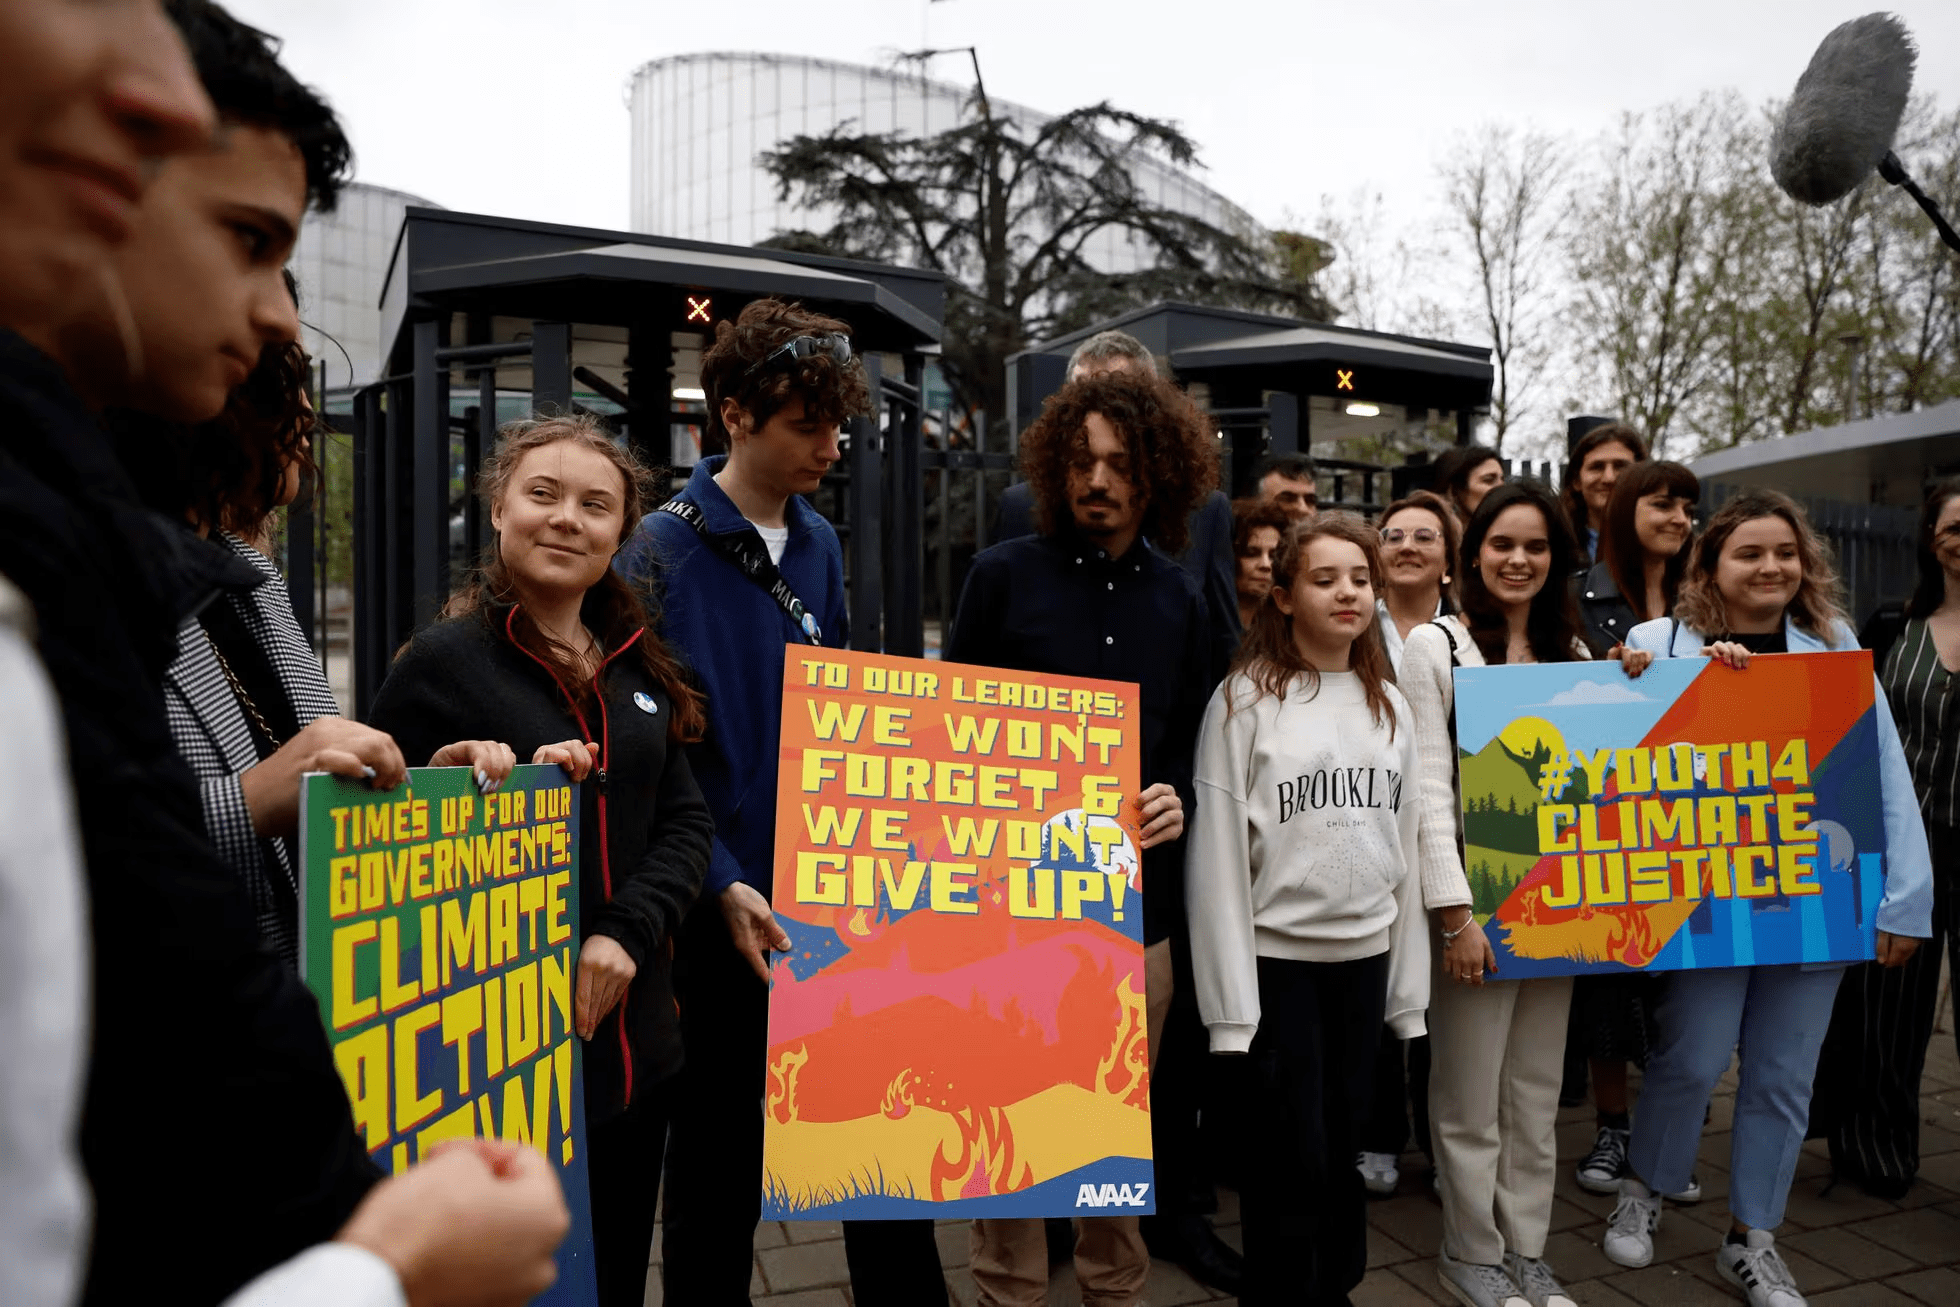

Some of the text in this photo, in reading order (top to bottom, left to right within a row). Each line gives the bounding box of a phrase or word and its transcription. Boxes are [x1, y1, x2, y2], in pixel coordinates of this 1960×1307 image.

[801, 659, 1123, 717] TO OUR LEADERS:
[808, 699, 1123, 764] WE WON'T
[802, 747, 1123, 817] FORGET &
[1537, 738, 1809, 800] #YOUTH4
[331, 786, 572, 850] TIME'S UP FOR OUR
[803, 803, 1123, 864] WE WON'T
[1326, 820, 1350, 828] CHILL
[1537, 794, 1819, 854] CLIMATE
[330, 821, 572, 919] GOVERNMENTS:
[796, 851, 1127, 923] GIVE UP!
[1541, 844, 1820, 907] JUSTICE
[333, 869, 573, 1031] CLIMATE
[334, 947, 573, 1152] ACTION
[1075, 1183, 1150, 1207] AVAAZ
